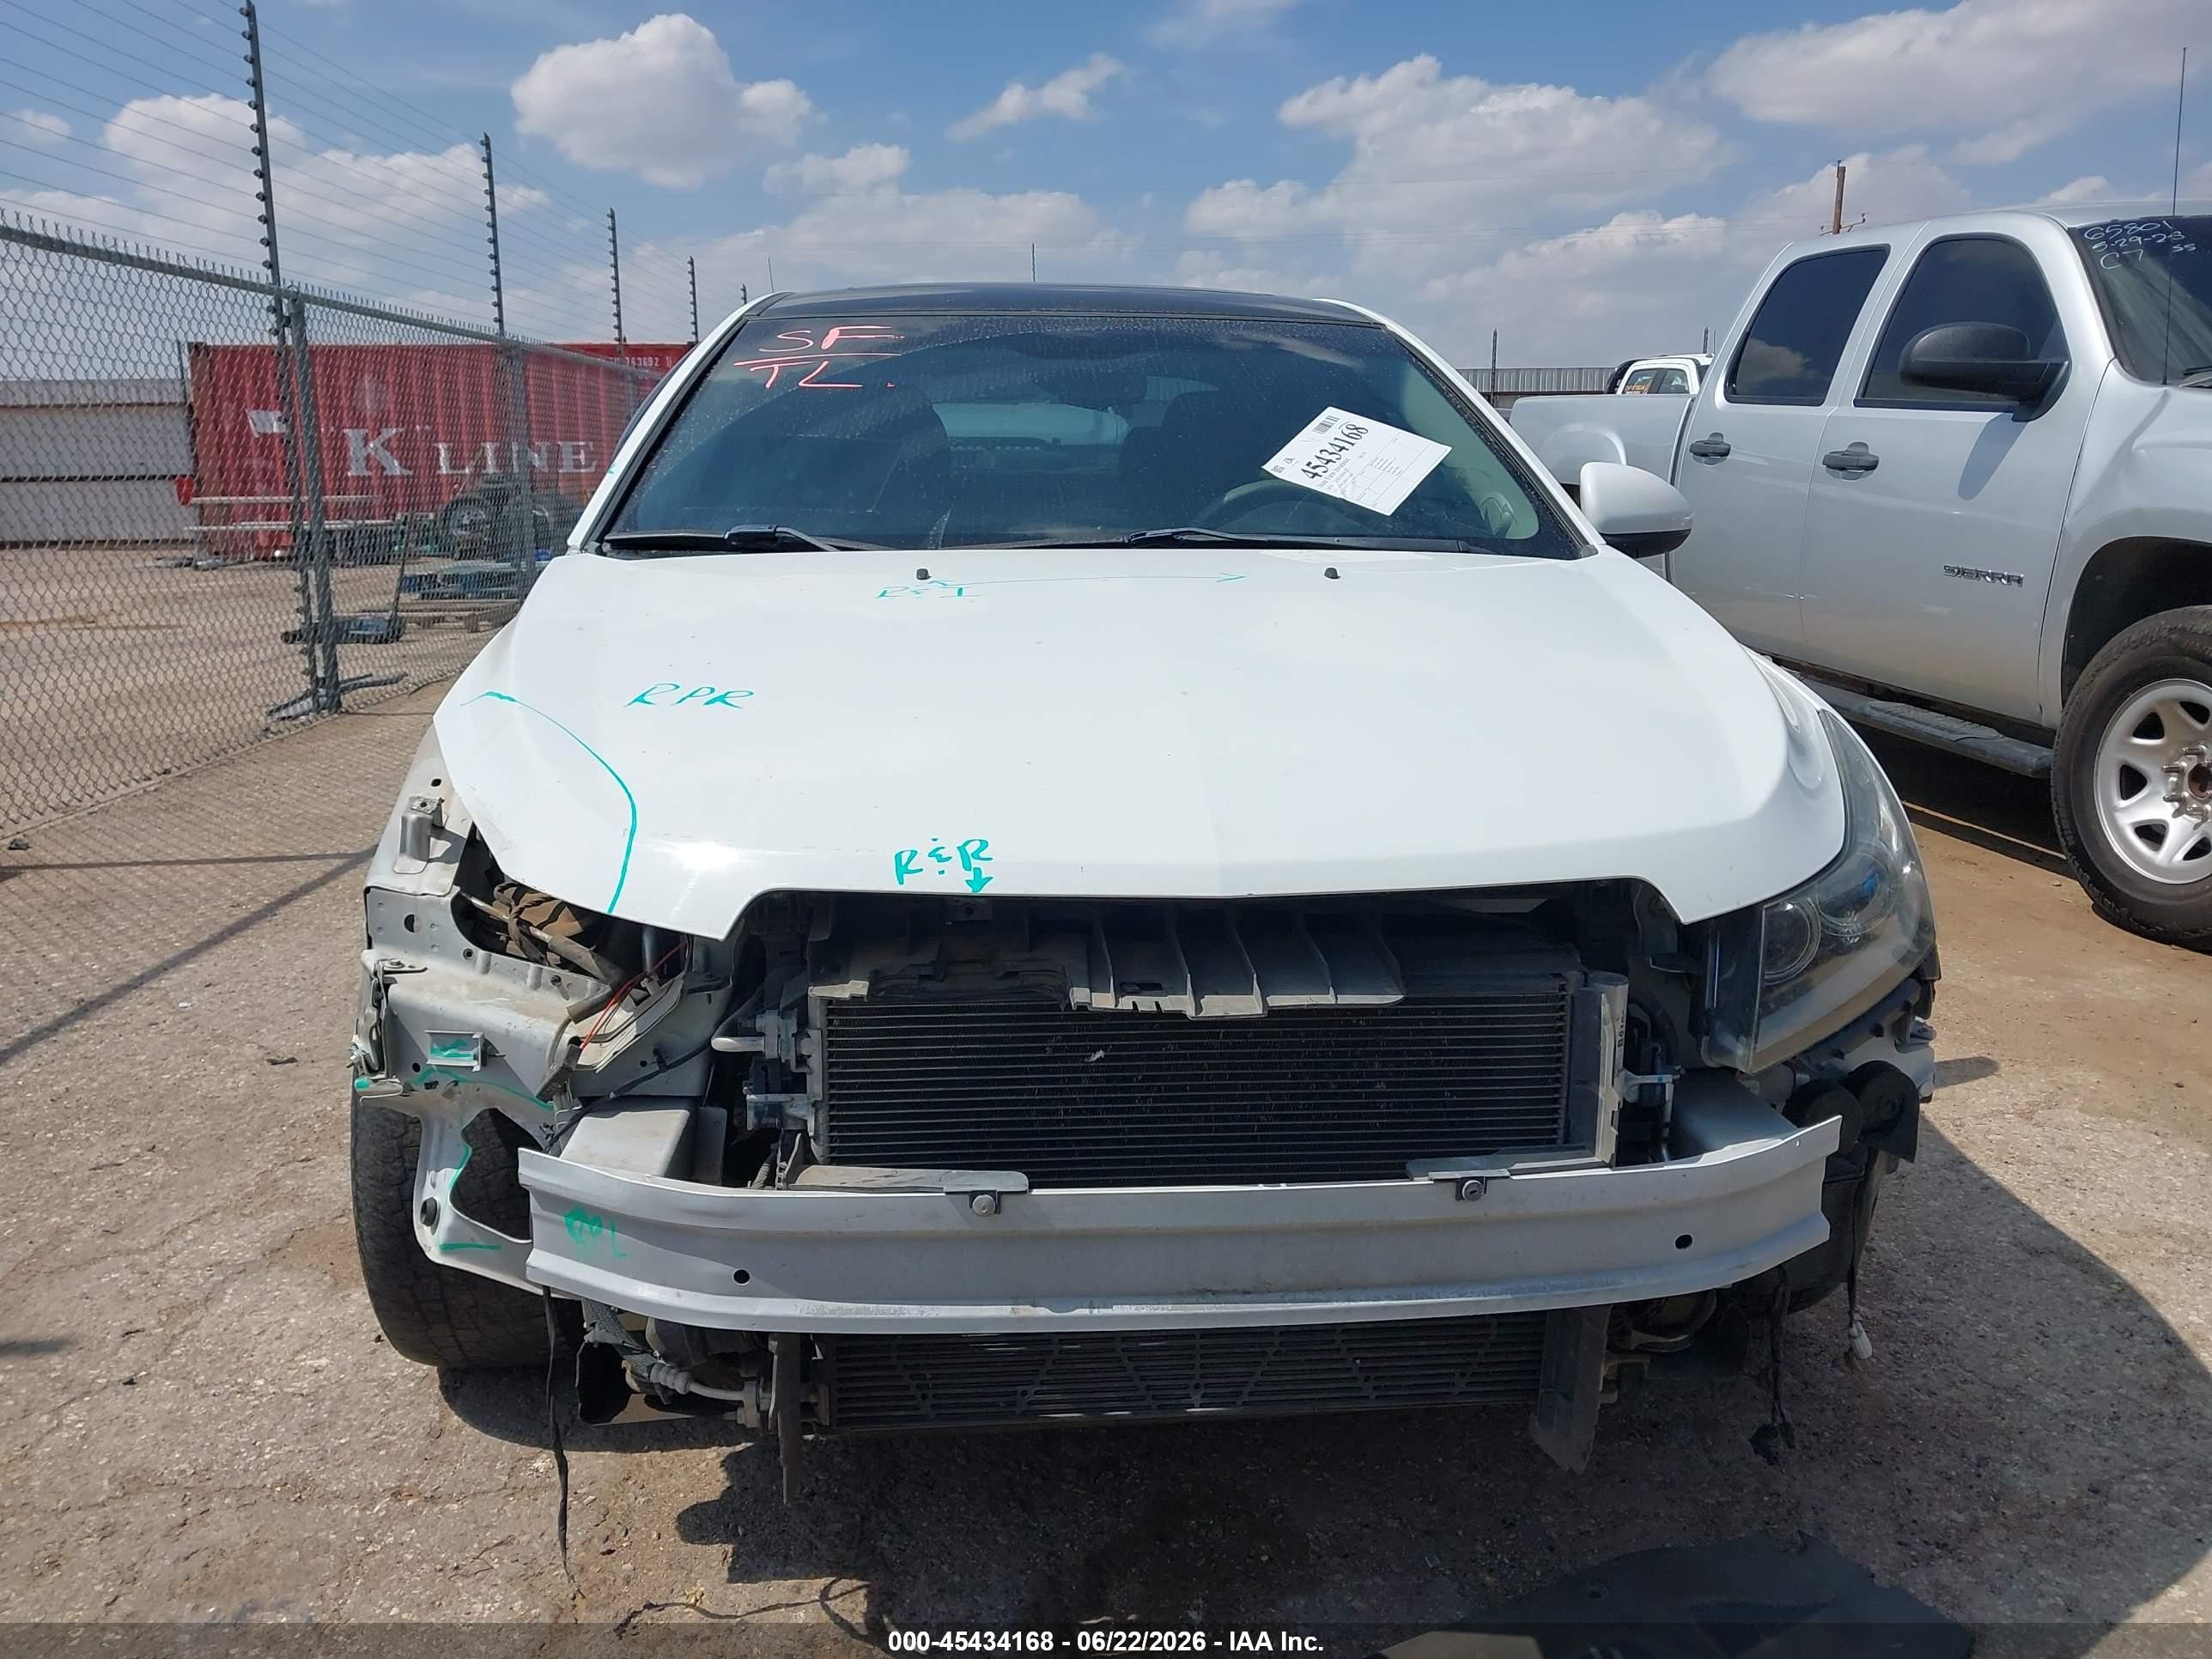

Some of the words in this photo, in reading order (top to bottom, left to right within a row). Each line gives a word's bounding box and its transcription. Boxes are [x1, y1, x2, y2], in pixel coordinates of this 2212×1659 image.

[759, 325, 905, 352] SF
[434, 441, 597, 474] LINE
[1300, 423, 1369, 479] 45434168
[1943, 565, 2025, 587] SIERRA
[623, 683, 755, 709] RPR
